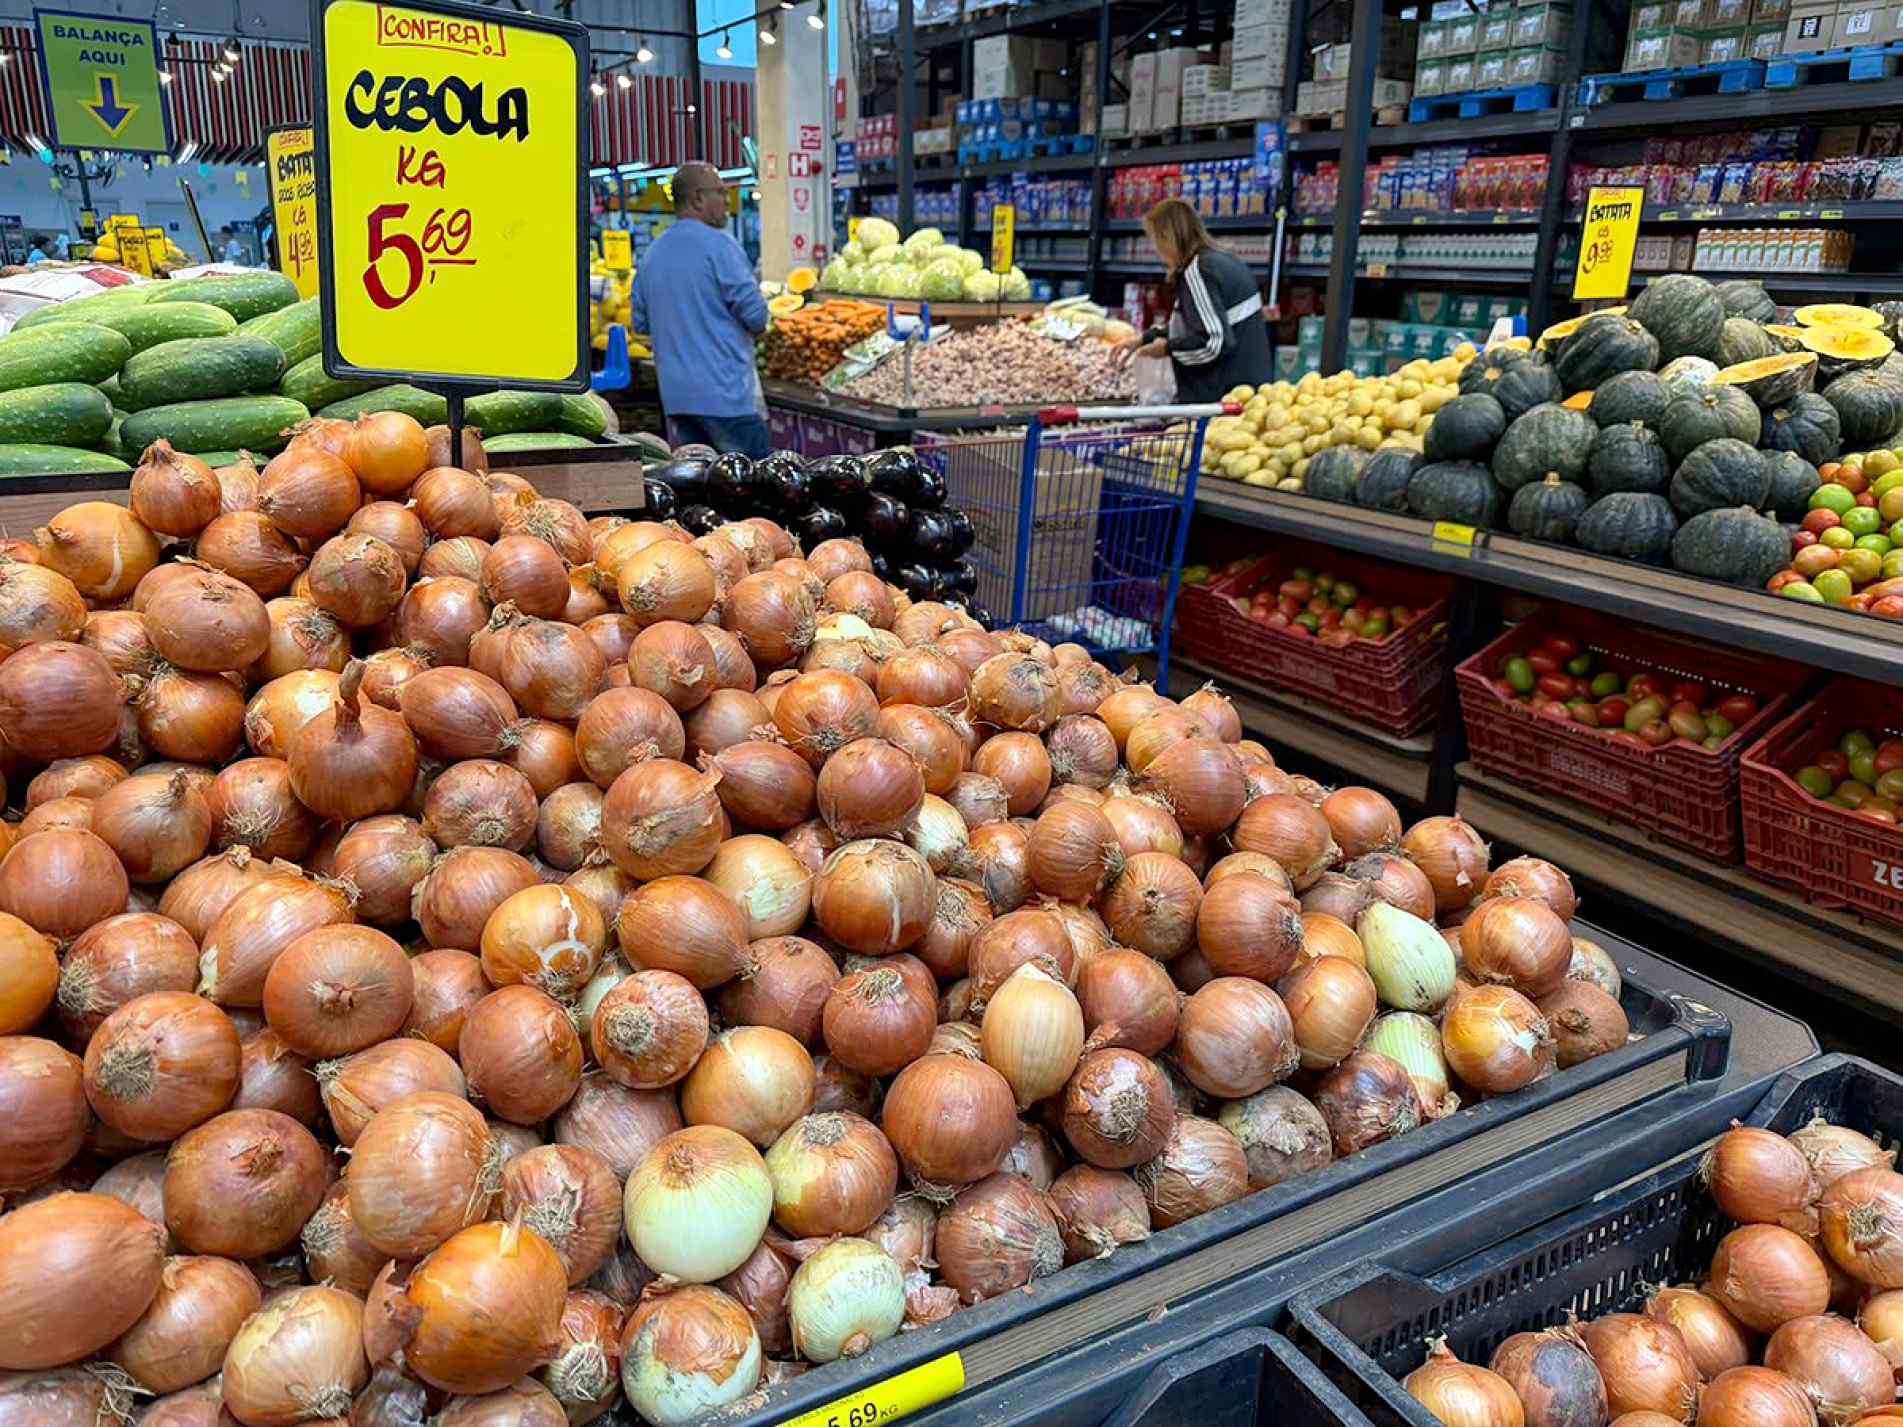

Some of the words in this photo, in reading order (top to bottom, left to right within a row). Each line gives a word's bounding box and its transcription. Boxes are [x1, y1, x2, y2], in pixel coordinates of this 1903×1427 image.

[53, 25, 145, 46] BALANÇA
[383, 14, 493, 55] CONFIRA!
[79, 49, 126, 66] AQUI
[344, 69, 530, 143] CEBOLA
[396, 145, 446, 190] KG
[1590, 203, 1632, 222] BATATA
